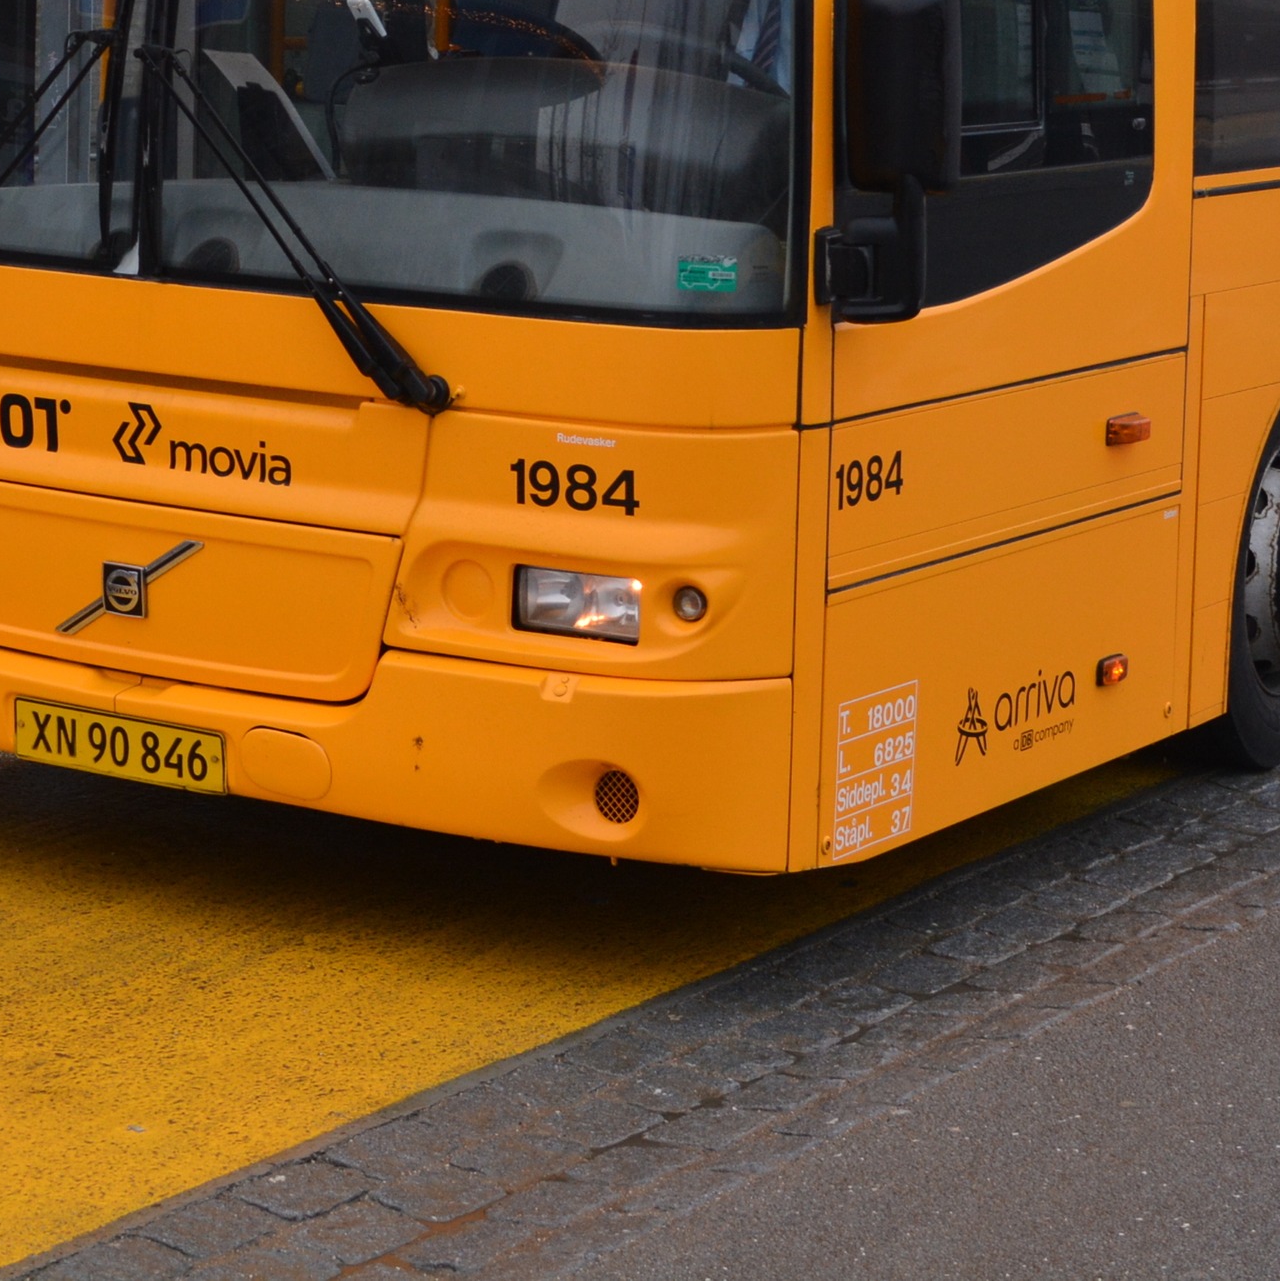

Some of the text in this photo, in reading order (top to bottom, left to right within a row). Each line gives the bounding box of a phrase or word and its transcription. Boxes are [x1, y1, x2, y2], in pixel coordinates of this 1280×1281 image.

[556, 432, 616, 448] Rudevasker
[169, 439, 291, 486] movia
[835, 450, 904, 510] 1984
[510, 458, 640, 516] 1984
[110, 584, 137, 596] VOLVO
[840, 694, 915, 735] T. 18000
[994, 669, 1075, 732] arriva
[32, 711, 208, 782] XN 90 846
[838, 731, 913, 773] L. 6825
[1013, 718, 1074, 751] a DB company
[837, 769, 912, 812] Siddepl. 34
[835, 806, 910, 850] Ståpl. 37
